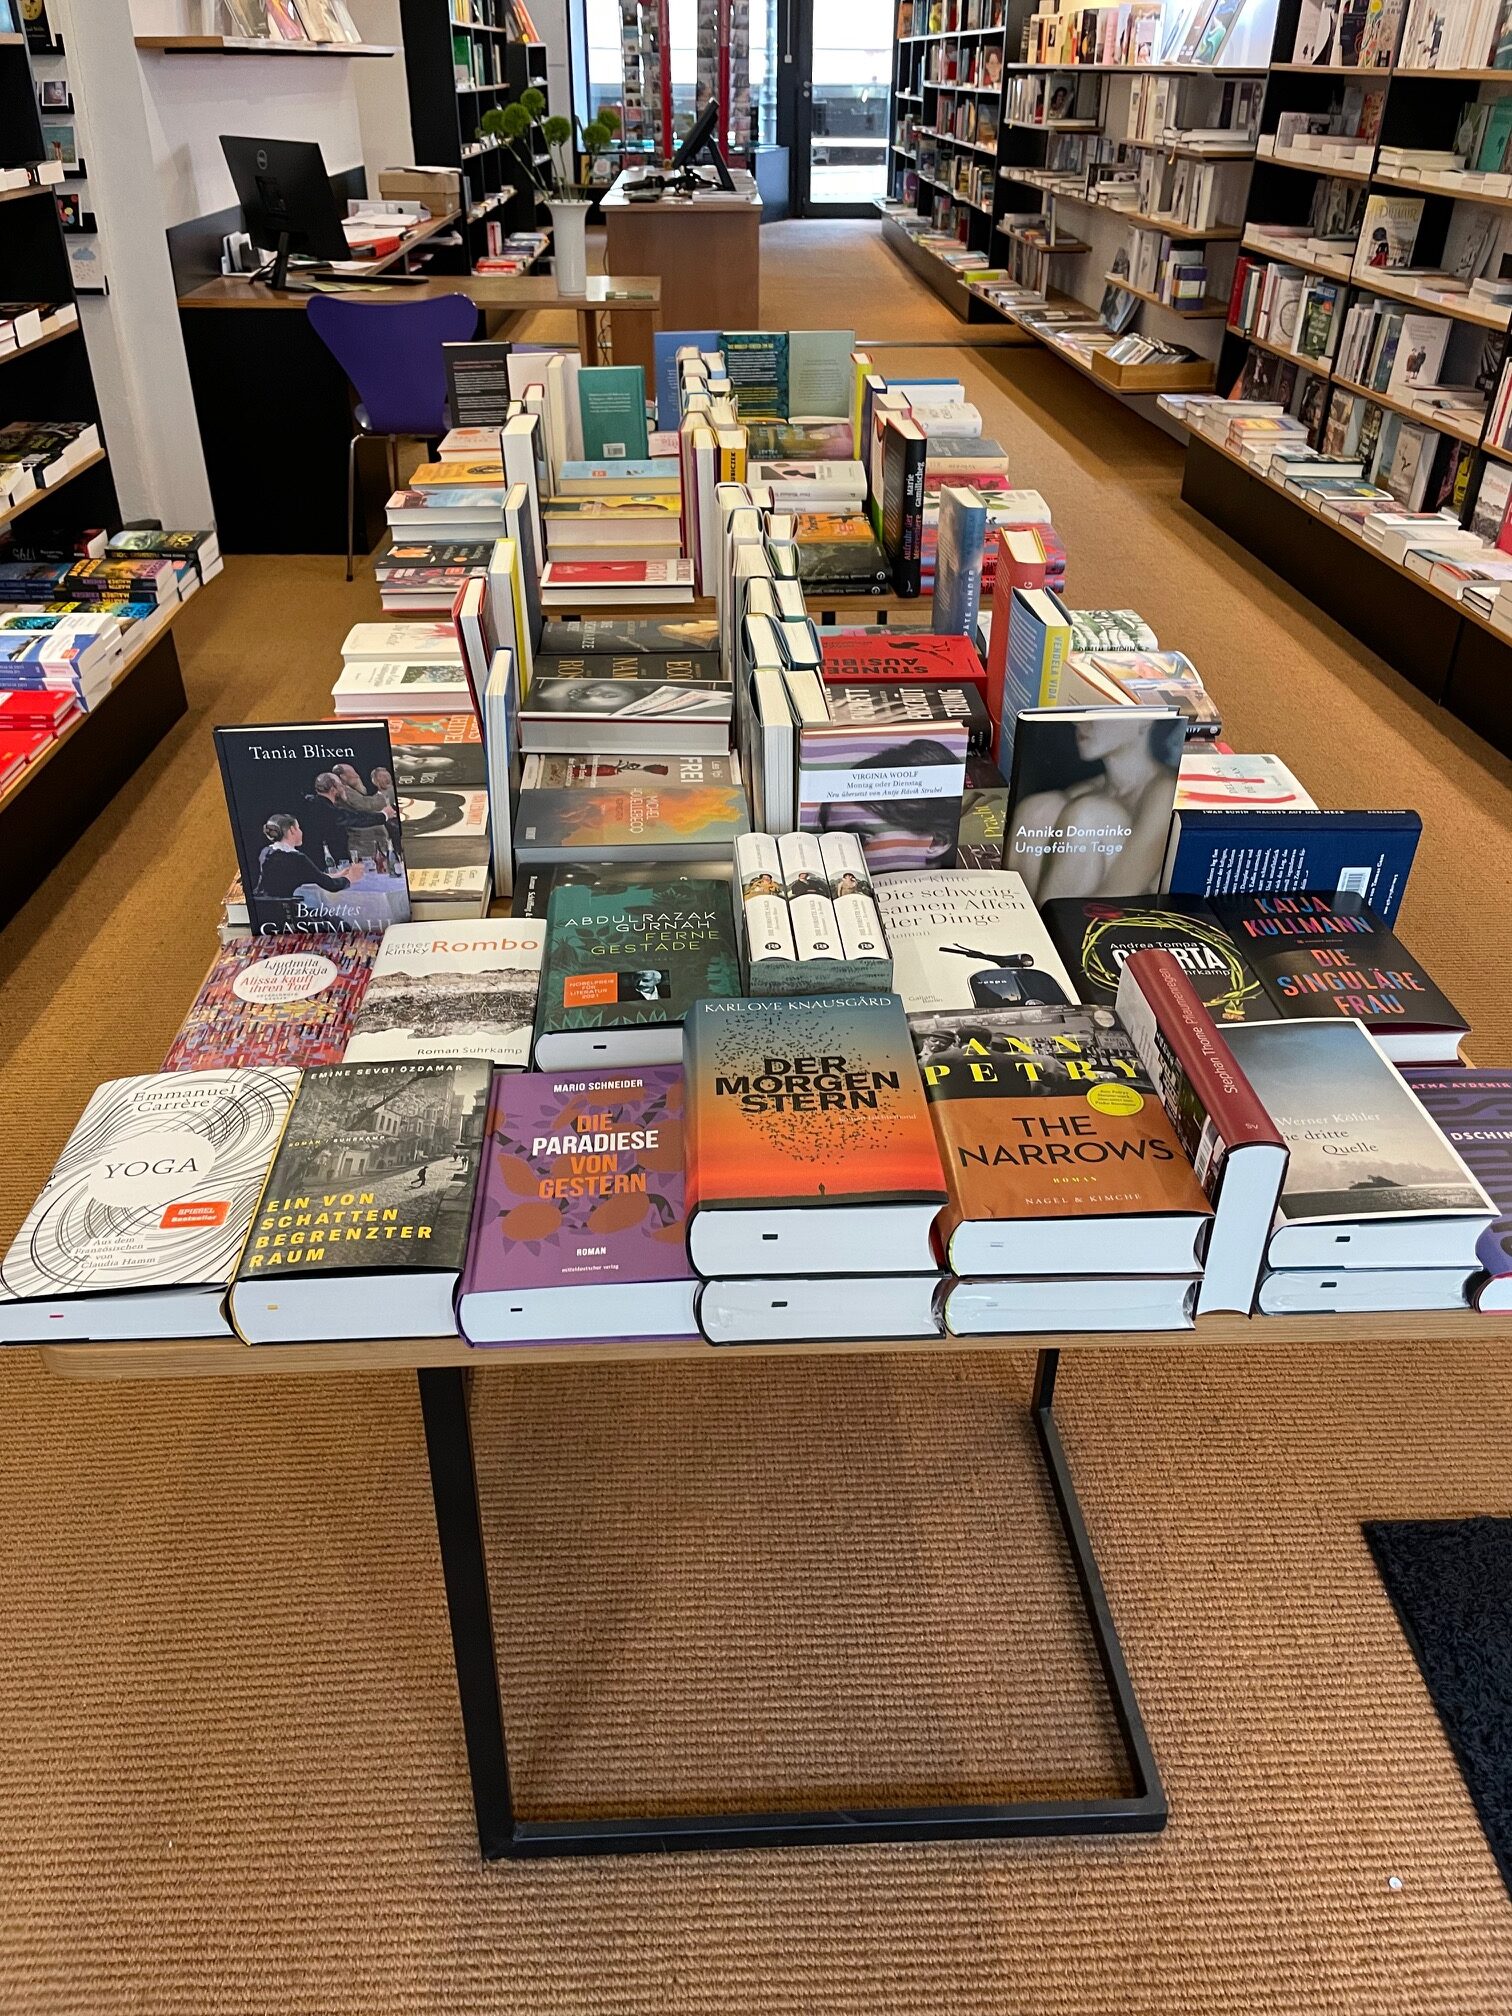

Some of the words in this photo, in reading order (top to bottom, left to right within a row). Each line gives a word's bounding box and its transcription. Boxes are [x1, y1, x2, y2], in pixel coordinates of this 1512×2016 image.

[906, 473, 914, 496] Marie
[963, 612, 973, 636] PÄTE
[557, 660, 585, 679] ROS
[612, 657, 639, 680] NAM
[822, 665, 929, 675] STUNDE
[248, 745, 297, 760] Tania
[303, 744, 355, 759] Blixen
[680, 756, 704, 783] FREI
[852, 772, 888, 780] VIRGINIA
[889, 771, 919, 779] WOOLF
[847, 782, 873, 790] Montag
[892, 780, 923, 788] Dienstag
[1016, 826, 1064, 838] Annika
[1066, 825, 1132, 837] Domainko
[1015, 841, 1087, 856] Ungefähre
[1091, 842, 1123, 856] Tage
[877, 889, 915, 903] Die
[921, 886, 1021, 900] schweig-
[297, 903, 361, 918] Babettes
[964, 898, 1026, 911] Affen
[1254, 896, 1332, 914] KATJA
[565, 911, 717, 927] ABDULRAZAK
[616, 921, 711, 932] GURNAH
[930, 911, 1001, 928] Dinge
[1243, 916, 1374, 938] KULLMANN
[645, 931, 720, 941] FERNE
[385, 948, 430, 956] Kinsky
[386, 941, 431, 950] Esther
[432, 938, 539, 953] Rombo
[591, 941, 701, 955] GESTADE
[1110, 942, 1155, 950] Andrea
[1156, 941, 1199, 950] Tompa
[265, 958, 319, 970] Ljudmila
[1310, 949, 1357, 967] DIE
[274, 967, 328, 976] Ulitzkaja
[1184, 968, 1233, 977] hrkamp
[240, 977, 278, 986] Alissa
[281, 975, 314, 984] kauft
[249, 984, 283, 993] ihren
[287, 982, 311, 991] Tod
[569, 979, 615, 987] NOBELPREIS
[1276, 968, 1426, 997] SINGULÄRE
[1159, 967, 1198, 1025] Pflaumenregen
[705, 1003, 746, 1013] KARL
[747, 1002, 783, 1011] OVE
[788, 996, 892, 1010] KNAUSGÅRD
[1332, 994, 1406, 1016] FRAU
[963, 1035, 1083, 1057] ANN
[1193, 1027, 1215, 1056] Thome
[417, 1048, 459, 1056] Roman
[463, 1046, 522, 1055] Suhrkamp
[400, 1064, 464, 1074] ÖZDAMAR
[763, 1055, 848, 1076] DER
[924, 1058, 1141, 1087] PETRY
[715, 1071, 901, 1096] MORGEN
[1210, 1057, 1238, 1095] Stephan
[134, 1085, 236, 1102] Emmanuel
[553, 1082, 586, 1093] MARIO
[588, 1079, 643, 1091] SCHNEIDER
[1411, 1082, 1448, 1090] ATMA
[137, 1098, 210, 1112] Carrère
[741, 1090, 879, 1113] STERN
[577, 1113, 613, 1133] DIE
[1012, 1115, 1098, 1138] THE
[1275, 1117, 1329, 1127] Werner
[1333, 1112, 1381, 1124] Köhler
[532, 1129, 659, 1156] PARADIESE
[1284, 1131, 1299, 1141] ie
[1304, 1129, 1350, 1141] dritte
[957, 1139, 1175, 1168] NARROWS
[1322, 1142, 1380, 1156] Quelle
[104, 1157, 199, 1180] YOGA
[570, 1154, 618, 1175] VON
[538, 1173, 647, 1199] GESTERN
[1052, 1176, 1098, 1184] ROMAN
[267, 1197, 310, 1213] EIN
[323, 1193, 375, 1207] VON
[1025, 1197, 1067, 1206] NAGEL
[1075, 1195, 1085, 1204] &
[1089, 1193, 1143, 1203] KIMCHE
[178, 1207, 216, 1216] SPIEGEL
[261, 1209, 398, 1231] SCHATTEN
[93, 1237, 114, 1246] Aus
[115, 1236, 135, 1244] dem
[255, 1226, 432, 1249] BEGRENZTER
[75, 1243, 144, 1255] Französischen
[576, 1247, 607, 1257] ROMAN
[81, 1257, 119, 1269] Claudia
[122, 1256, 156, 1267] Hamm
[249, 1248, 325, 1268] RAUM
